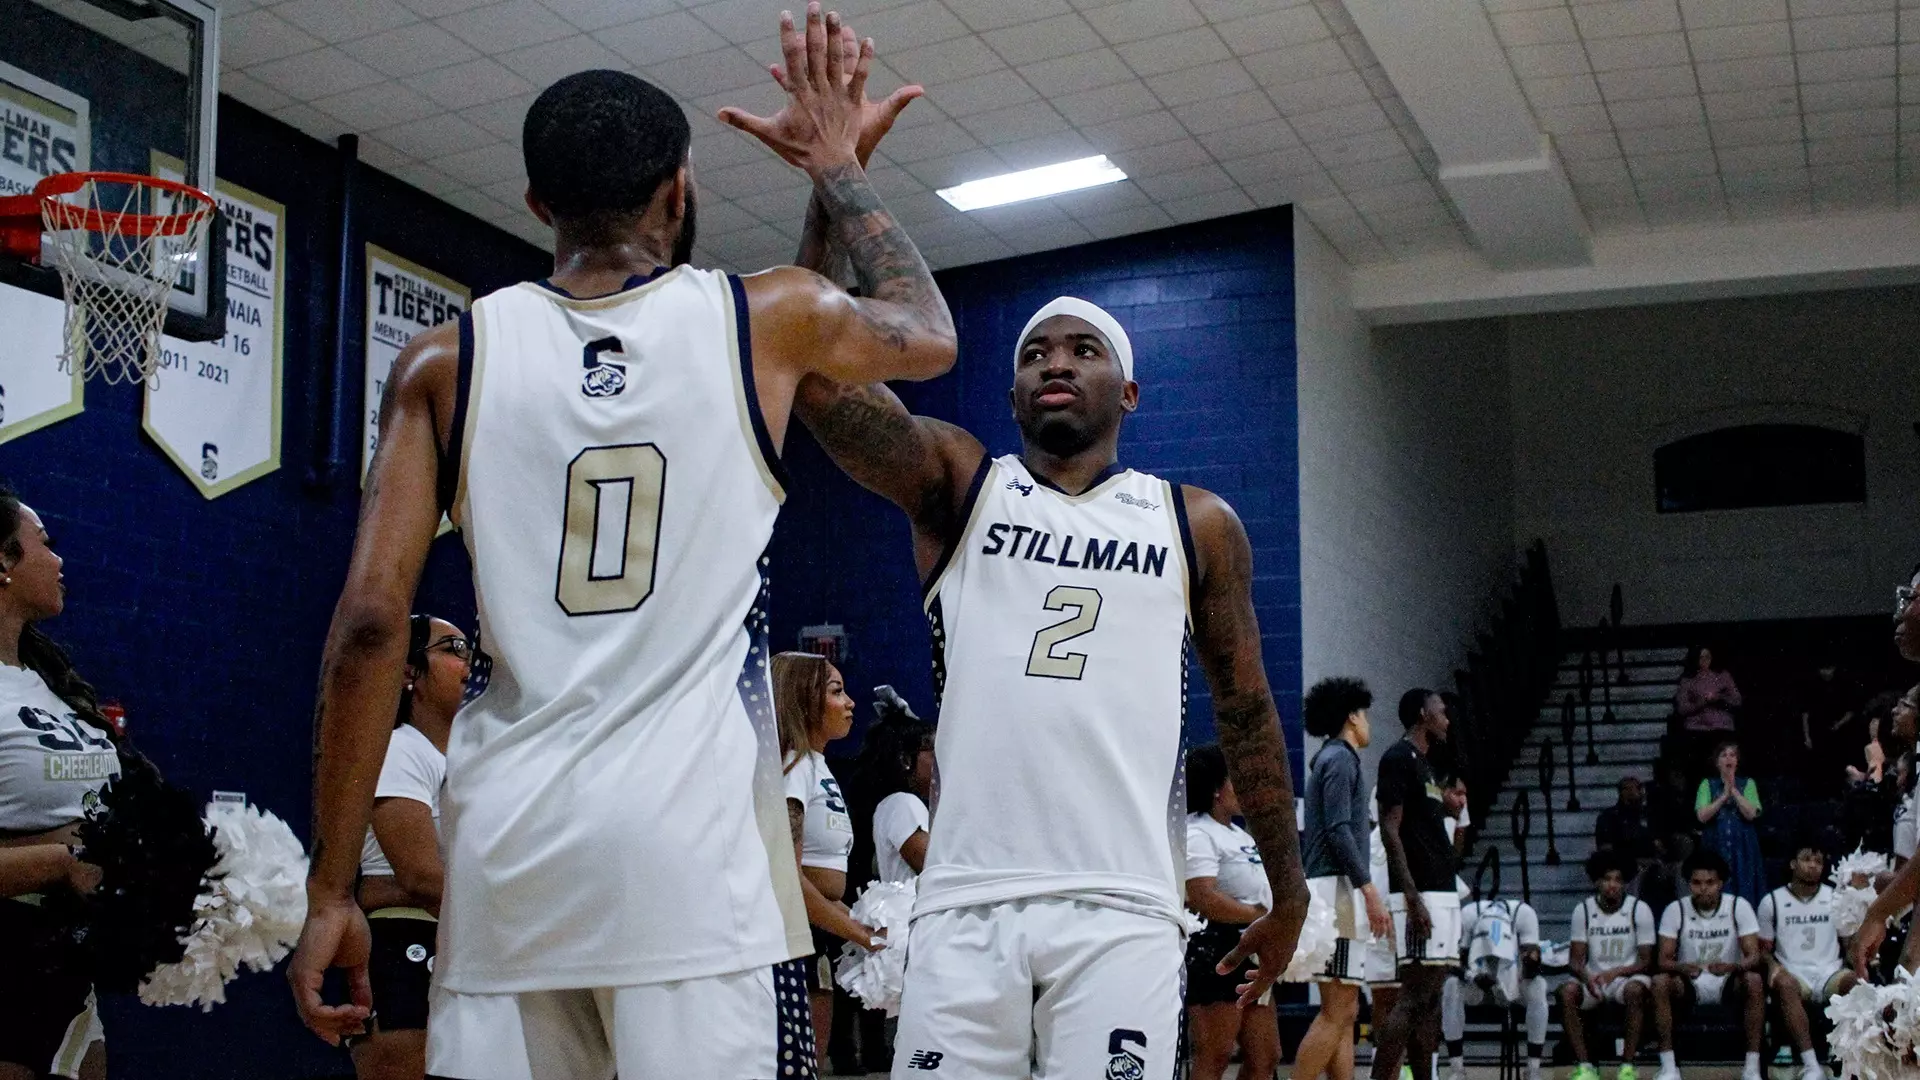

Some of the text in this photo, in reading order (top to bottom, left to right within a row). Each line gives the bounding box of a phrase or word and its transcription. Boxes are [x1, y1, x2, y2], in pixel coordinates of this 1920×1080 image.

[394, 273, 446, 304] STILLMAN
[227, 297, 262, 328] NAIA
[233, 334, 251, 355] 16
[198, 361, 229, 384] 2021
[555, 442, 667, 617] 0
[982, 522, 1169, 578] STILLMAN
[1025, 585, 1103, 680] 2
[1588, 926, 1630, 936] STILLMAN
[1785, 914, 1829, 925] STILLMAN
[1688, 928, 1729, 939] STILLMAN
[1800, 926, 1816, 951] 3
